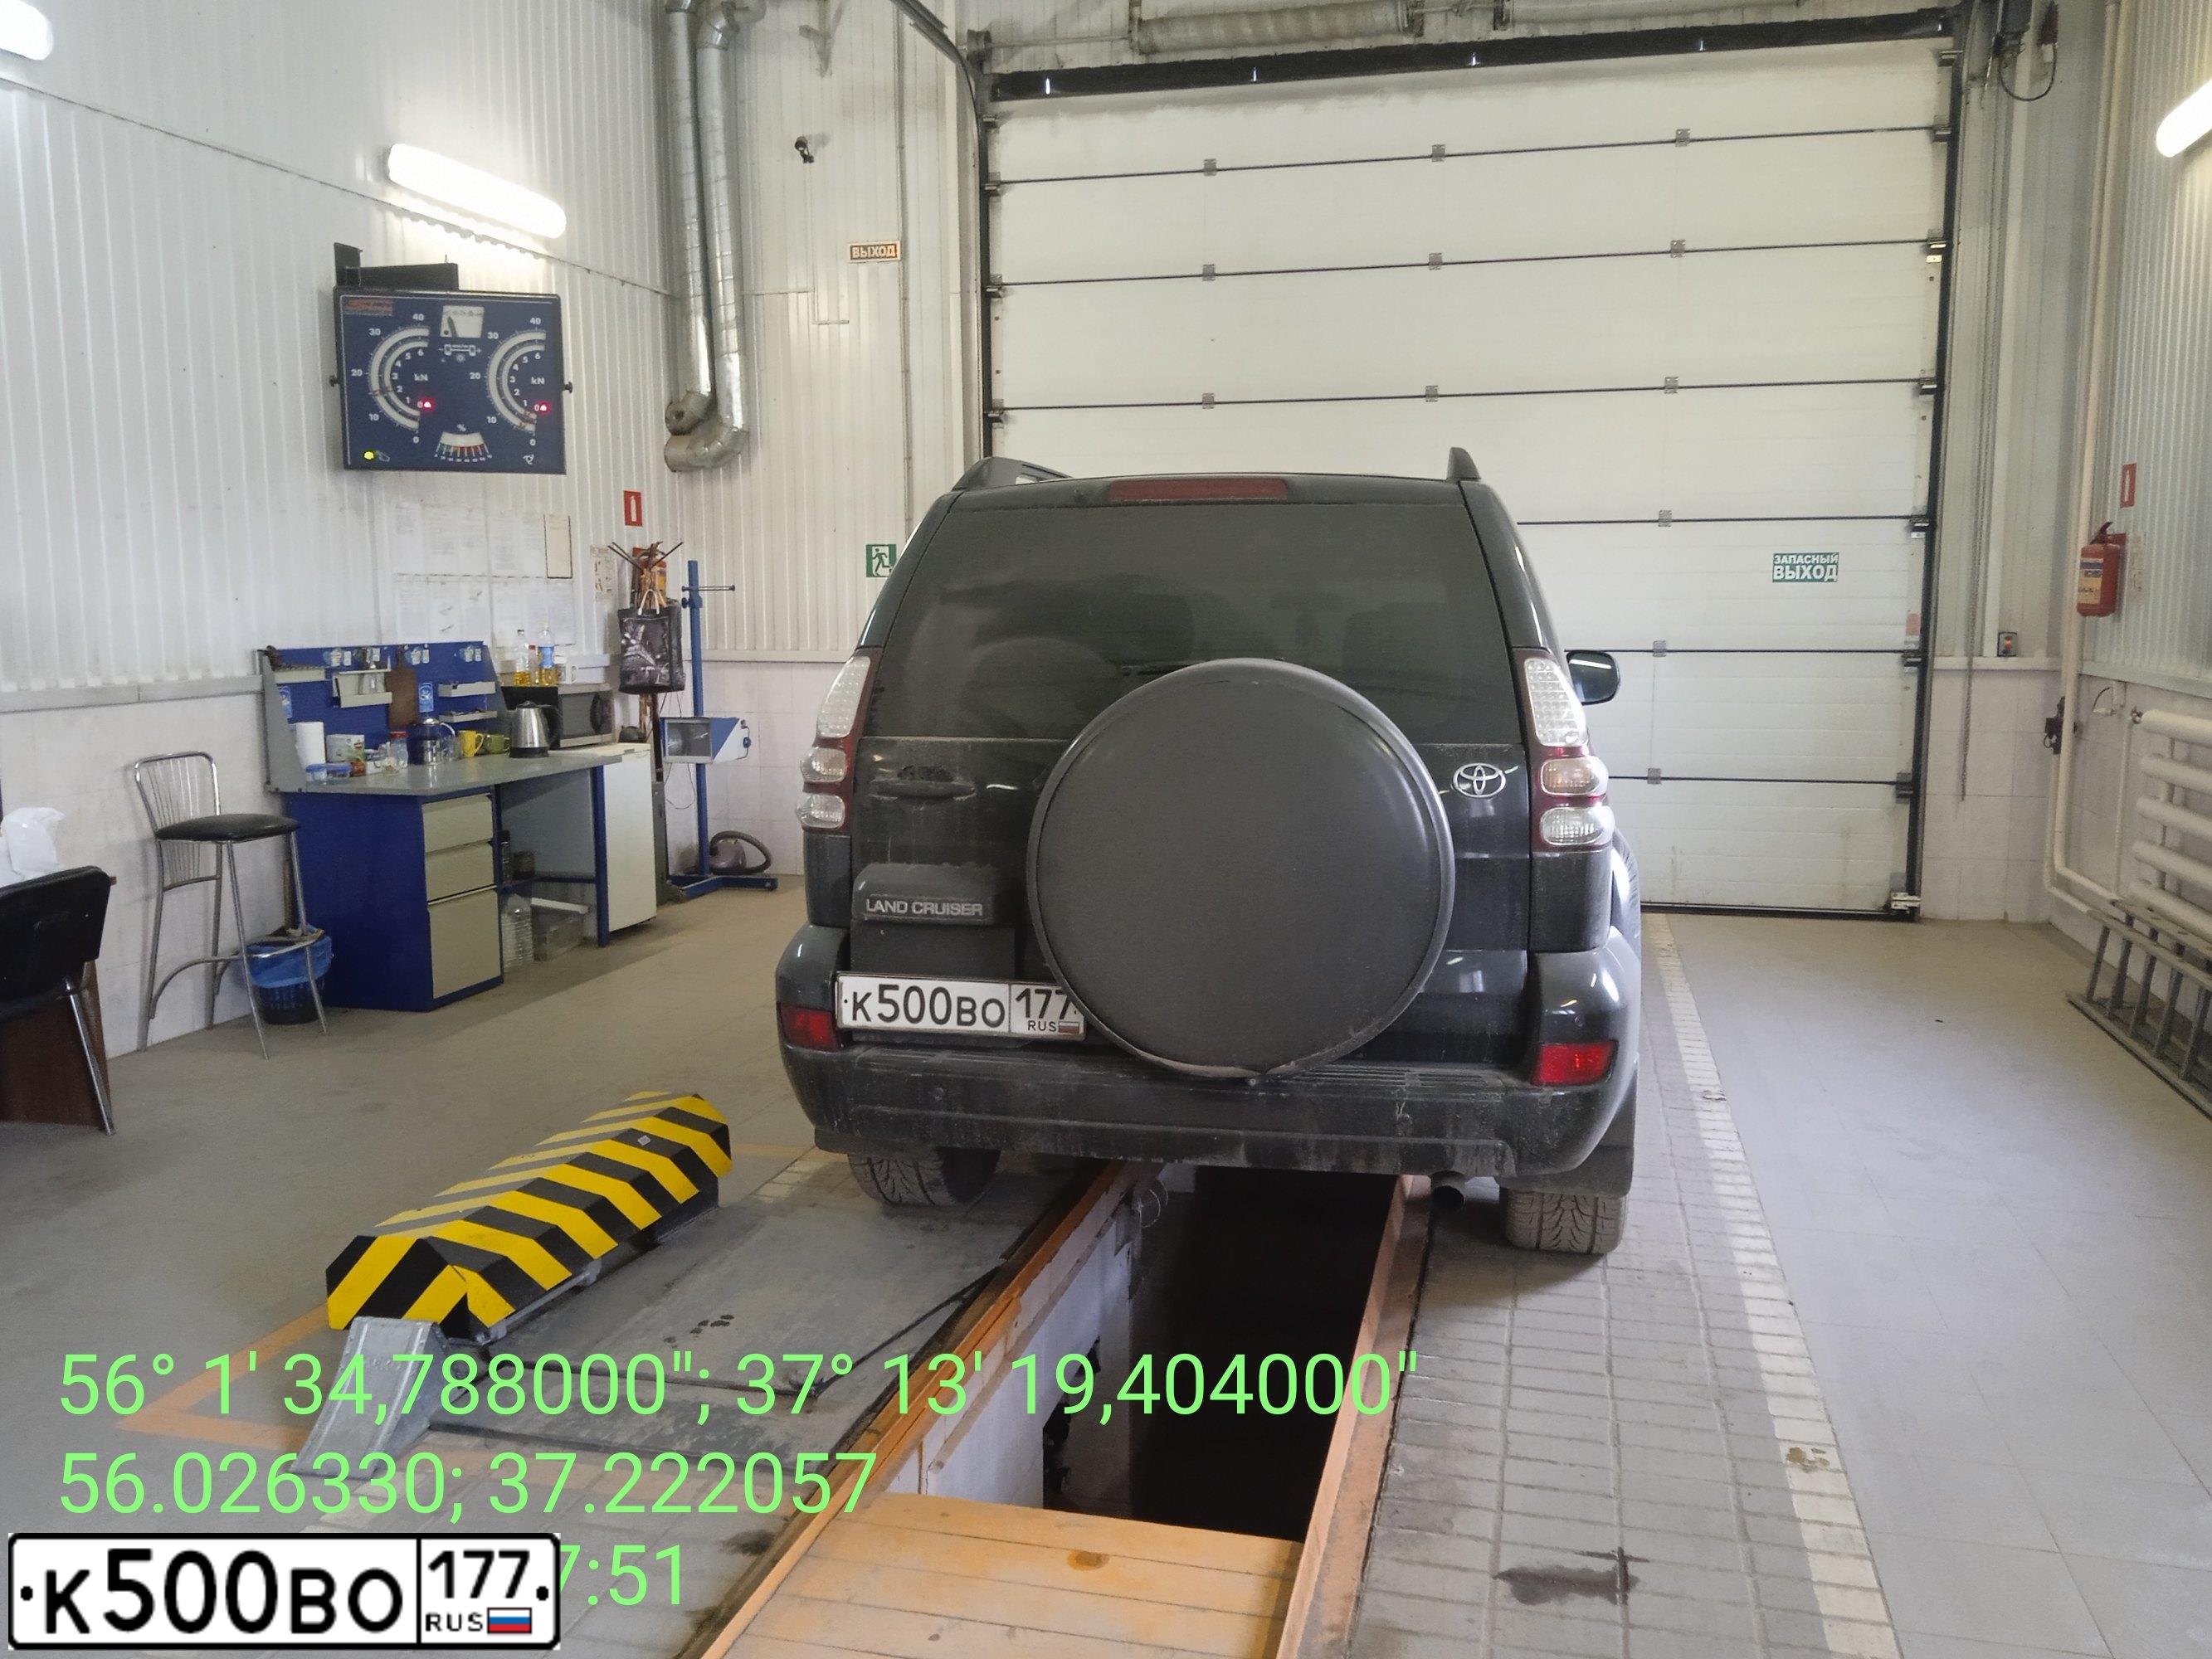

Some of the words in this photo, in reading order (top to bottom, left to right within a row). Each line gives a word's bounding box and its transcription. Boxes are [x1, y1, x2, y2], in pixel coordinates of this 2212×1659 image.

[852, 245, 896, 259] ВЫХОД
[368, 328, 381, 336] 30
[531, 377, 545, 385] kN
[1774, 553, 1839, 564] ЗАПАСНЫЙ
[1773, 564, 1837, 581] ВЫХОД
[866, 898, 908, 913] LAND
[912, 901, 982, 917] CRUISER
[1015, 987, 1071, 1019] 177
[1028, 1019, 1057, 1032] RUS
